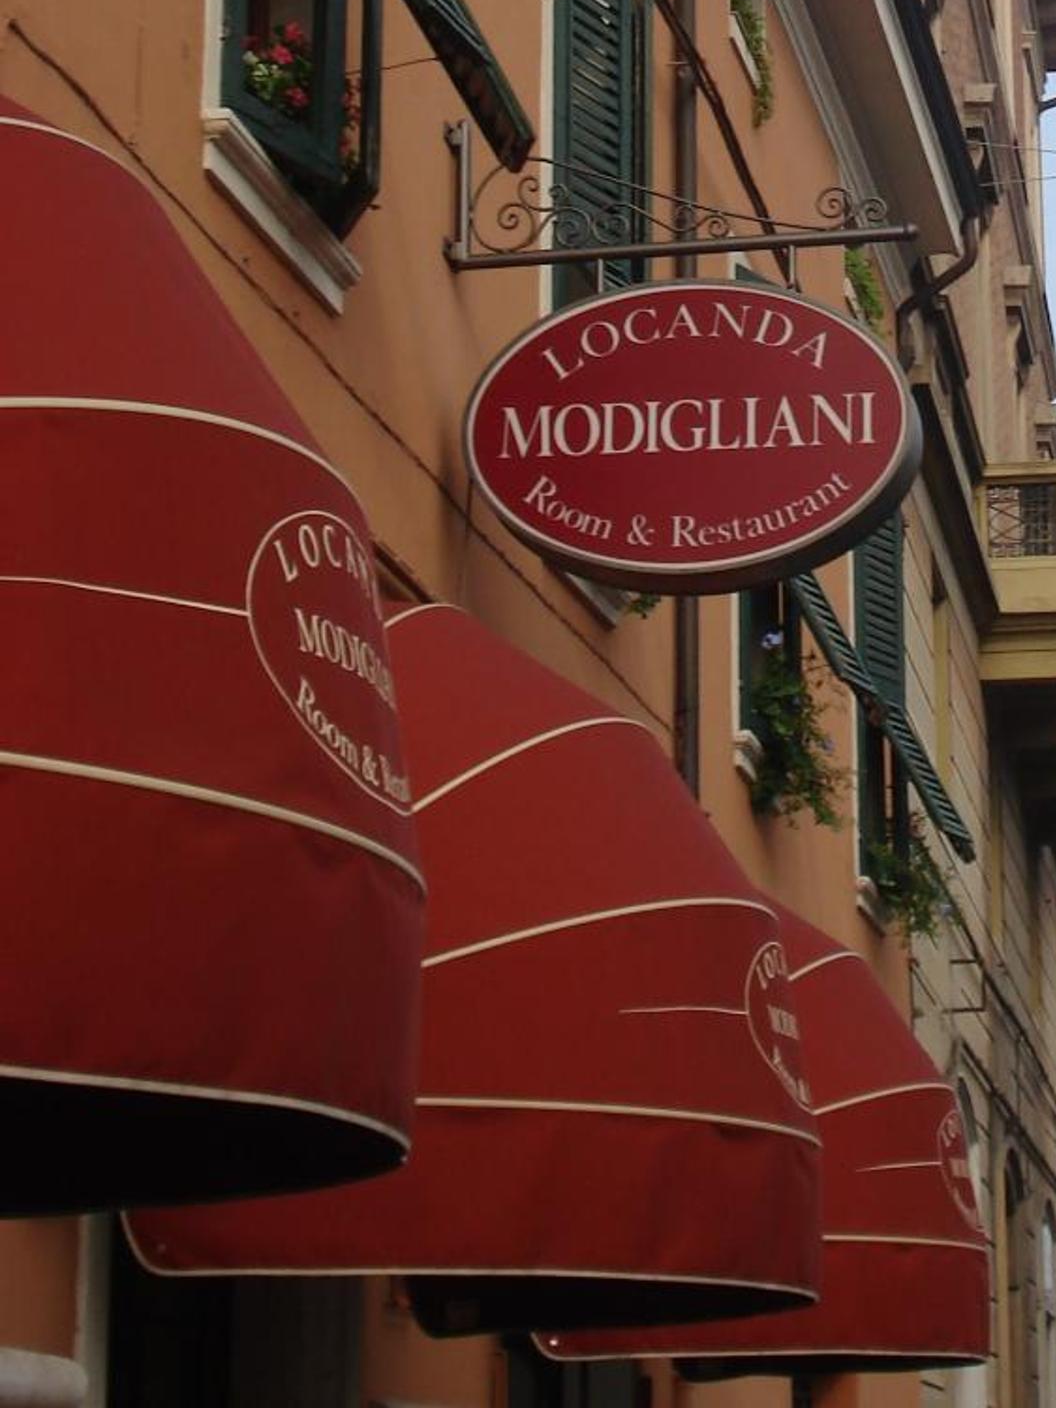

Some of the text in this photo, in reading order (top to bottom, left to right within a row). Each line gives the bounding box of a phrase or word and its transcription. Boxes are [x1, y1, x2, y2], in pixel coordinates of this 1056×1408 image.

[541, 302, 829, 381] LOCANDA
[498, 391, 877, 459] MODIGLIANI
[522, 470, 853, 548] Room & Restaurant
[296, 677, 360, 772] Room
[361, 744, 380, 787] &
